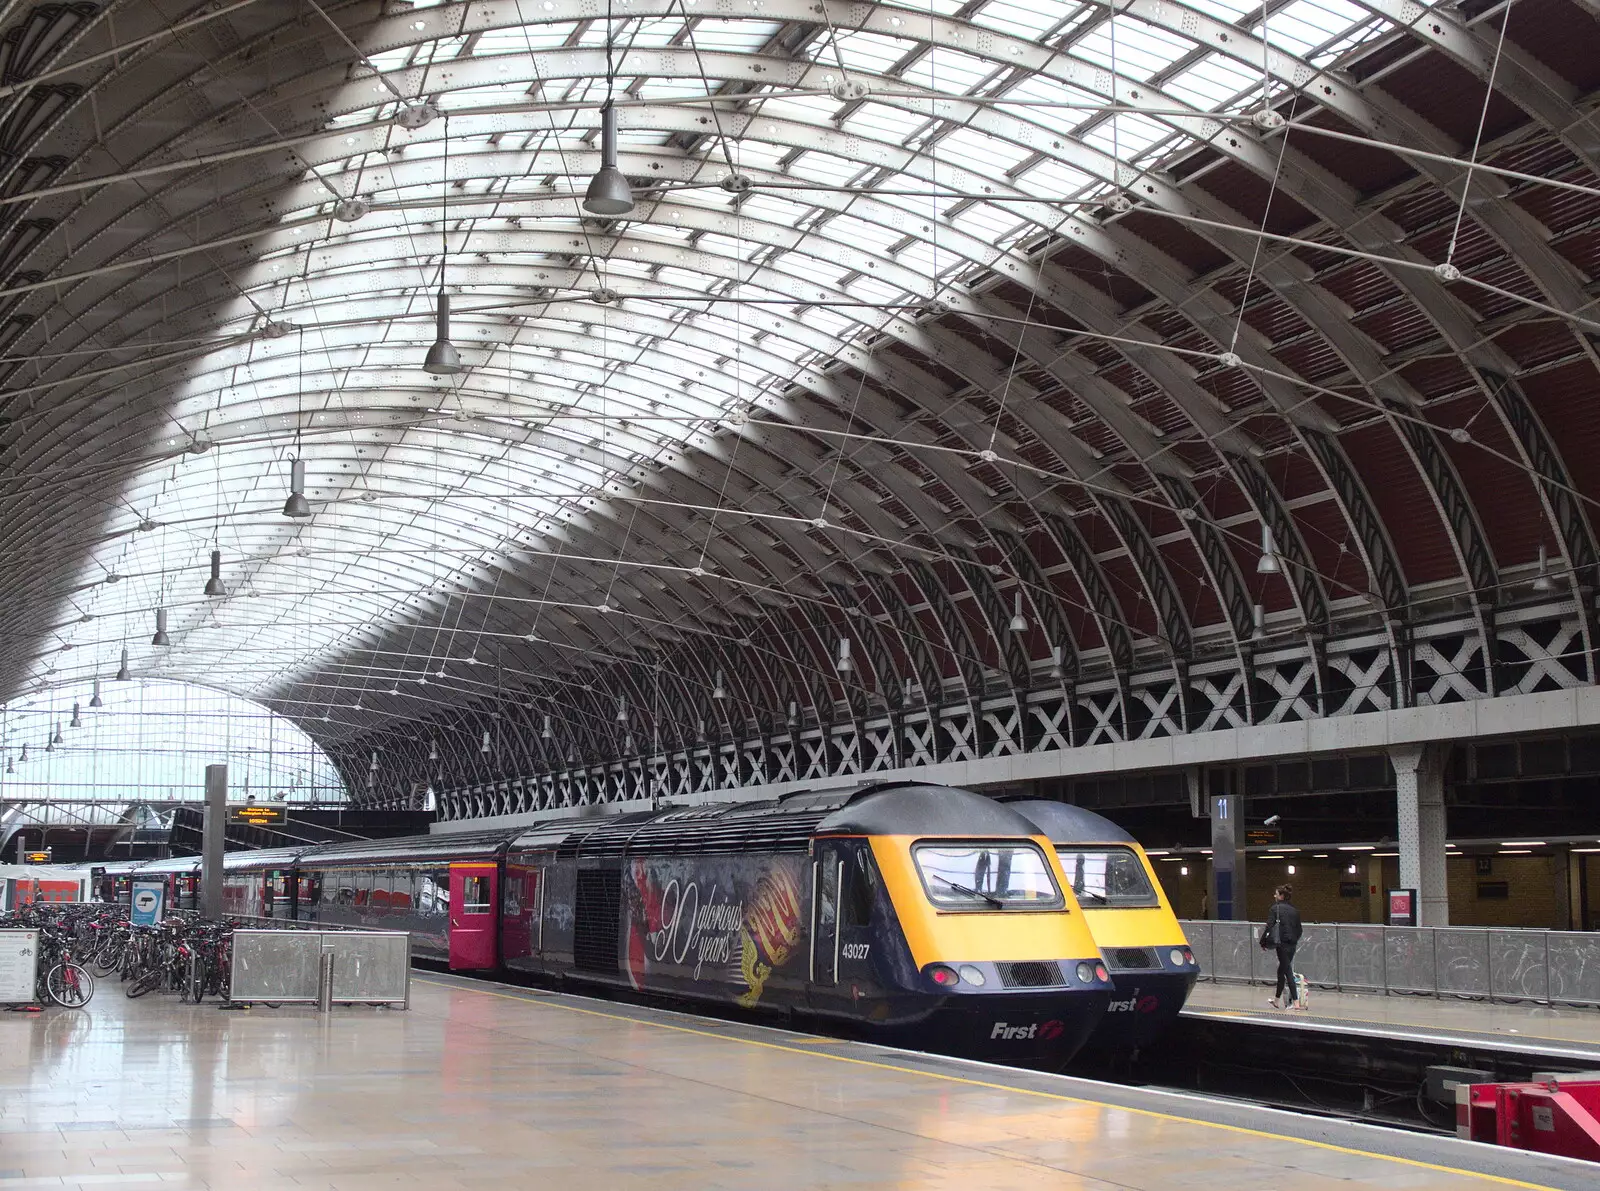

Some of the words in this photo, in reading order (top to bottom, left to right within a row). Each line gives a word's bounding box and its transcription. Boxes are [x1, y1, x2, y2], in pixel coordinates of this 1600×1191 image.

[1217, 798, 1227, 819] 11
[655, 879, 699, 964] 90
[691, 884, 742, 949] glorious
[694, 932, 730, 981] years
[842, 943, 870, 959] 43027
[1107, 998, 1137, 1012] irst
[990, 1022, 1037, 1040] First
